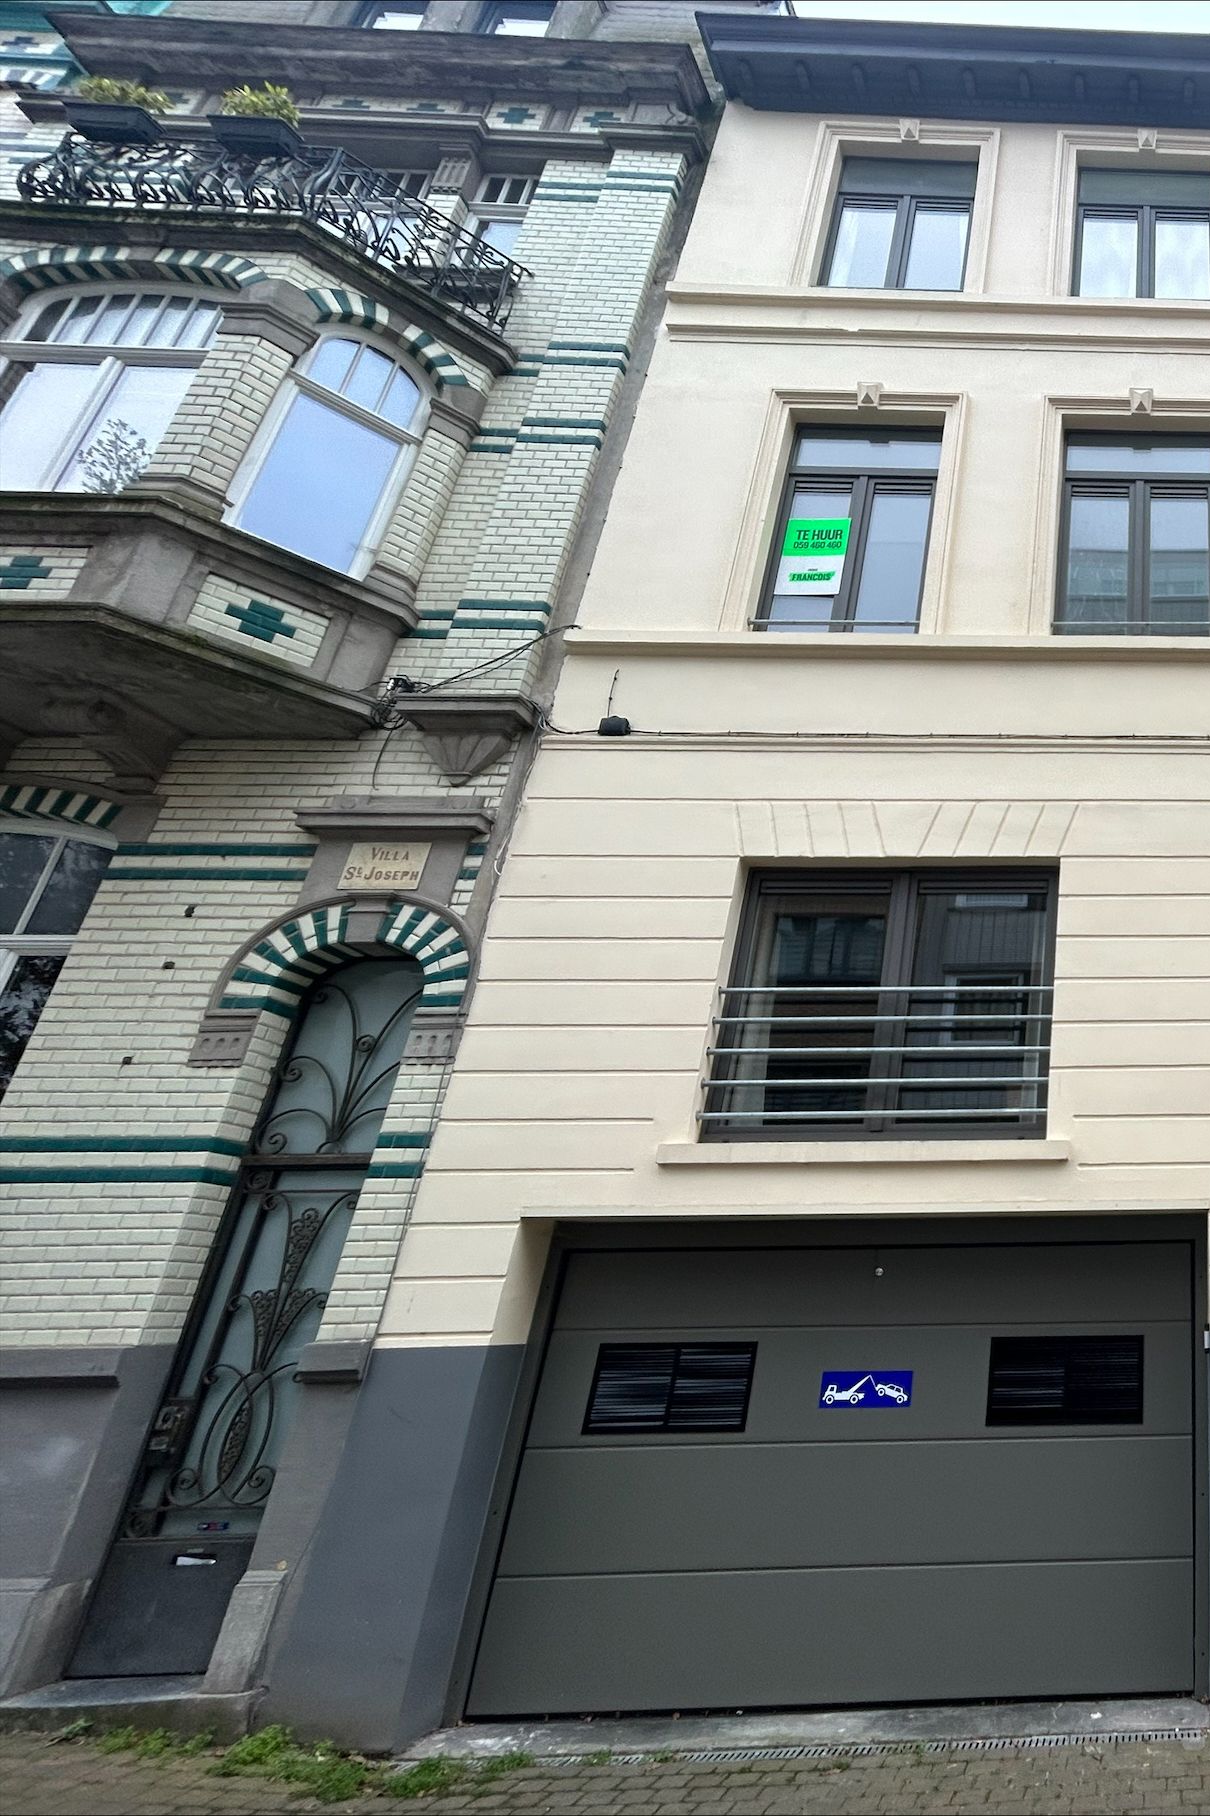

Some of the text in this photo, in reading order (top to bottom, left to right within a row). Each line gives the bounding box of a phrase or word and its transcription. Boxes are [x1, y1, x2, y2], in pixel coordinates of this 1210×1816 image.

[796, 530, 843, 540] TE HUUR
[371, 847, 409, 861] VILLA
[344, 866, 419, 881] St JOSEPH
